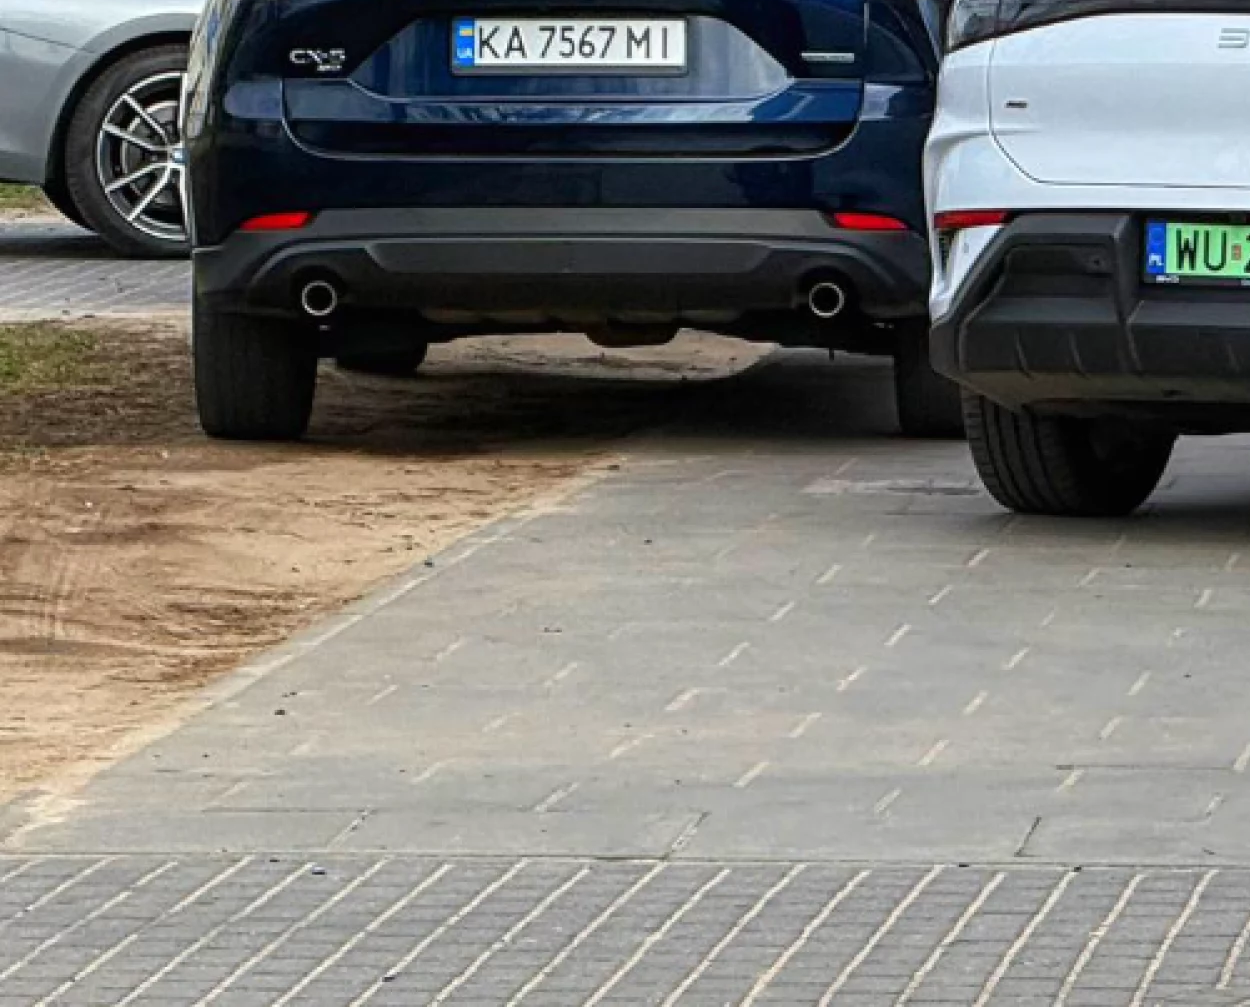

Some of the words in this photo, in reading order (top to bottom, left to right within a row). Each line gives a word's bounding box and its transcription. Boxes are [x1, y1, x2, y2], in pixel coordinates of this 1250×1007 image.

[479, 25, 528, 59] KA
[539, 25, 616, 59] 7567
[626, 25, 668, 59] MI
[1175, 228, 1227, 271] WU
